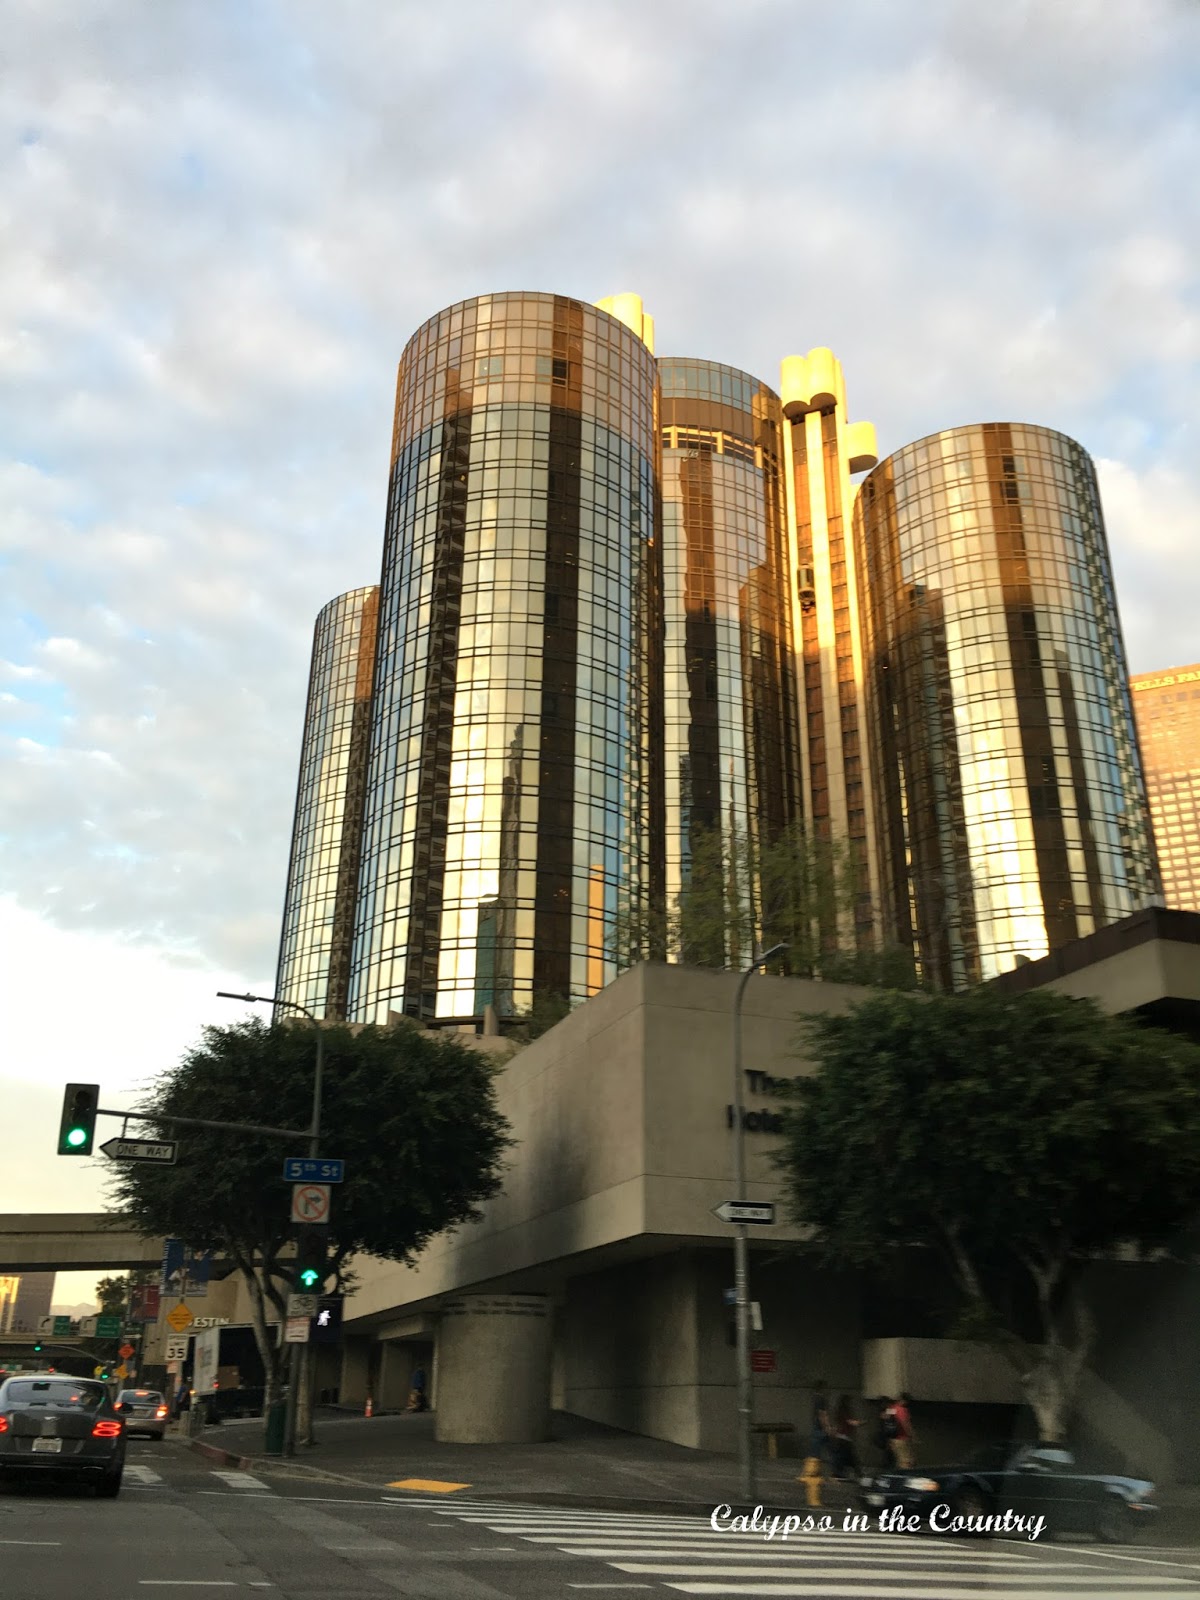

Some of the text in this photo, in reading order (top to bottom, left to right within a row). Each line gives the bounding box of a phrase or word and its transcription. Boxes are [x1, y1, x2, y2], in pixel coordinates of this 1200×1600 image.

[117, 1144, 170, 1156] ONE WAY
[321, 1164, 339, 1177] St
[193, 1317, 230, 1328] ESTIN
[167, 1348, 185, 1359] 35
